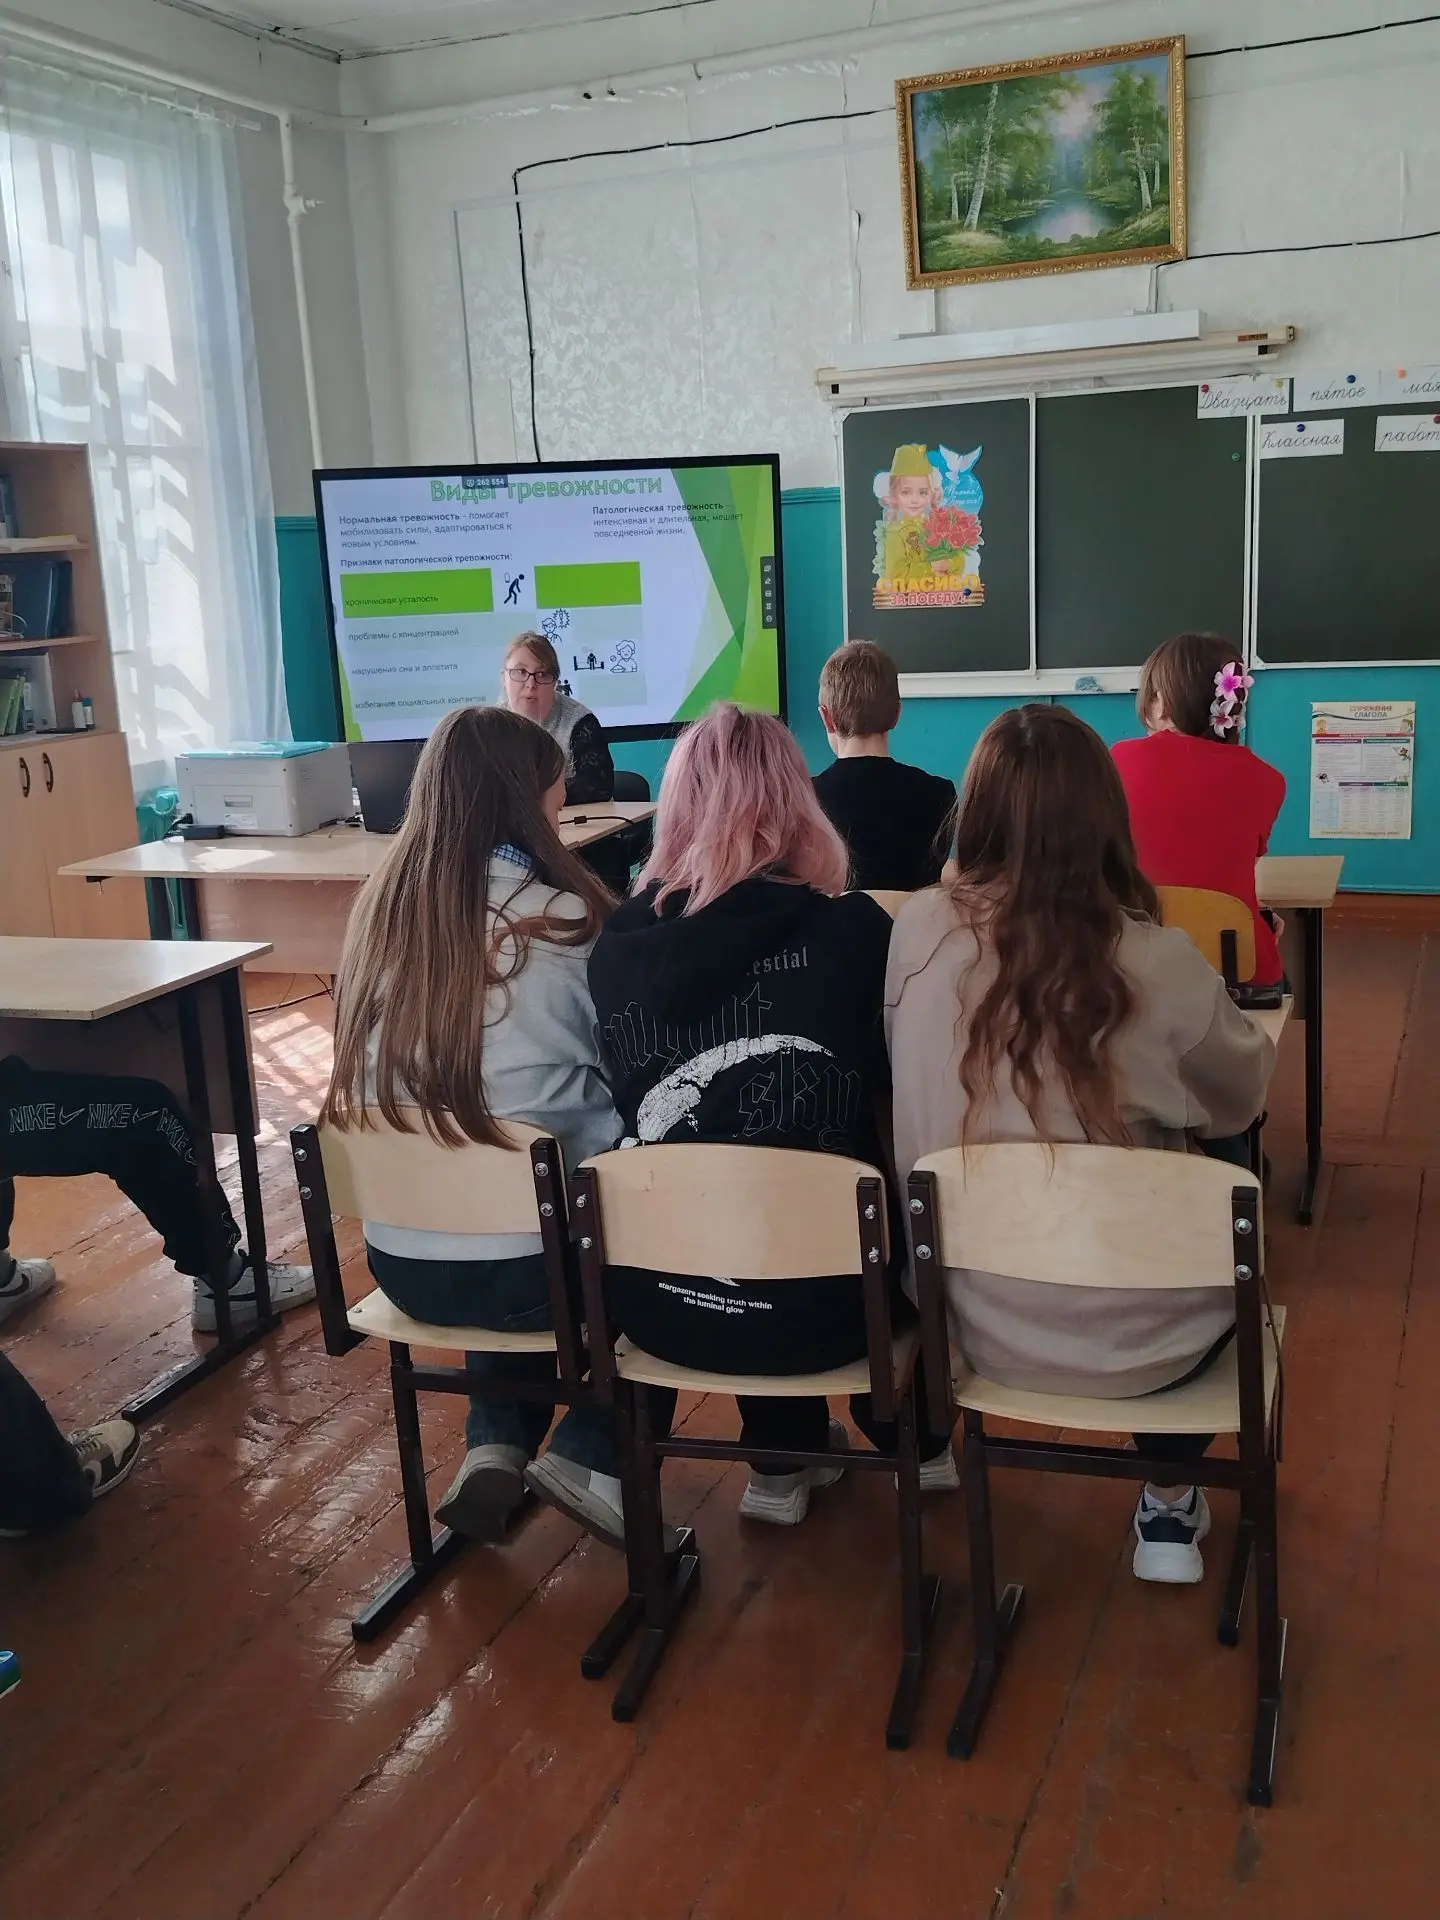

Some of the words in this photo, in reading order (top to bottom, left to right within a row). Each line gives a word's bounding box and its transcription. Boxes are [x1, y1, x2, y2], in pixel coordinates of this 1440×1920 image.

[1261, 430, 1342, 450] Классная
[430, 480, 497, 505] Виды
[508, 477, 662, 503] тревожности
[592, 504, 664, 516] Патологическая
[667, 502, 723, 514] тревожность
[339, 514, 397, 525] Нормальная
[399, 513, 460, 524] тревожность
[469, 511, 510, 520] помогает
[593, 516, 648, 527] интенсивная
[712, 512, 744, 522] мешает
[340, 526, 403, 537] мобилизовать
[434, 522, 504, 534] адаптироваться
[594, 527, 654, 538] повседневной
[341, 540, 371, 549] новым
[340, 557, 382, 568] Признаки
[384, 554, 453, 566] патологической
[454, 552, 513, 564] тревожности:
[879, 575, 980, 593] СПАСИБО
[345, 597, 397, 607] хроническая
[399, 595, 439, 606] усталость
[890, 593, 906, 606] ЗА
[348, 630, 390, 642] проблемы
[399, 628, 459, 640] концентрацией
[352, 666, 397, 677] нарушения
[398, 666, 413, 674] сна
[355, 700, 396, 710] избегание
[397, 698, 446, 708] социальных
[1354, 711, 1388, 719] ГЛАГОЛА
[745, 944, 809, 976] estial
[9, 1103, 57, 1133] NIKE
[86, 1103, 133, 1129] NIKE
[658, 1282, 696, 1297] stargazers
[697, 1291, 726, 1304] seeking
[726, 1297, 747, 1307] truth
[747, 1300, 773, 1310] within
[683, 1296, 696, 1305] the
[697, 1298, 725, 1312] luminal
[725, 1304, 745, 1314] glow
